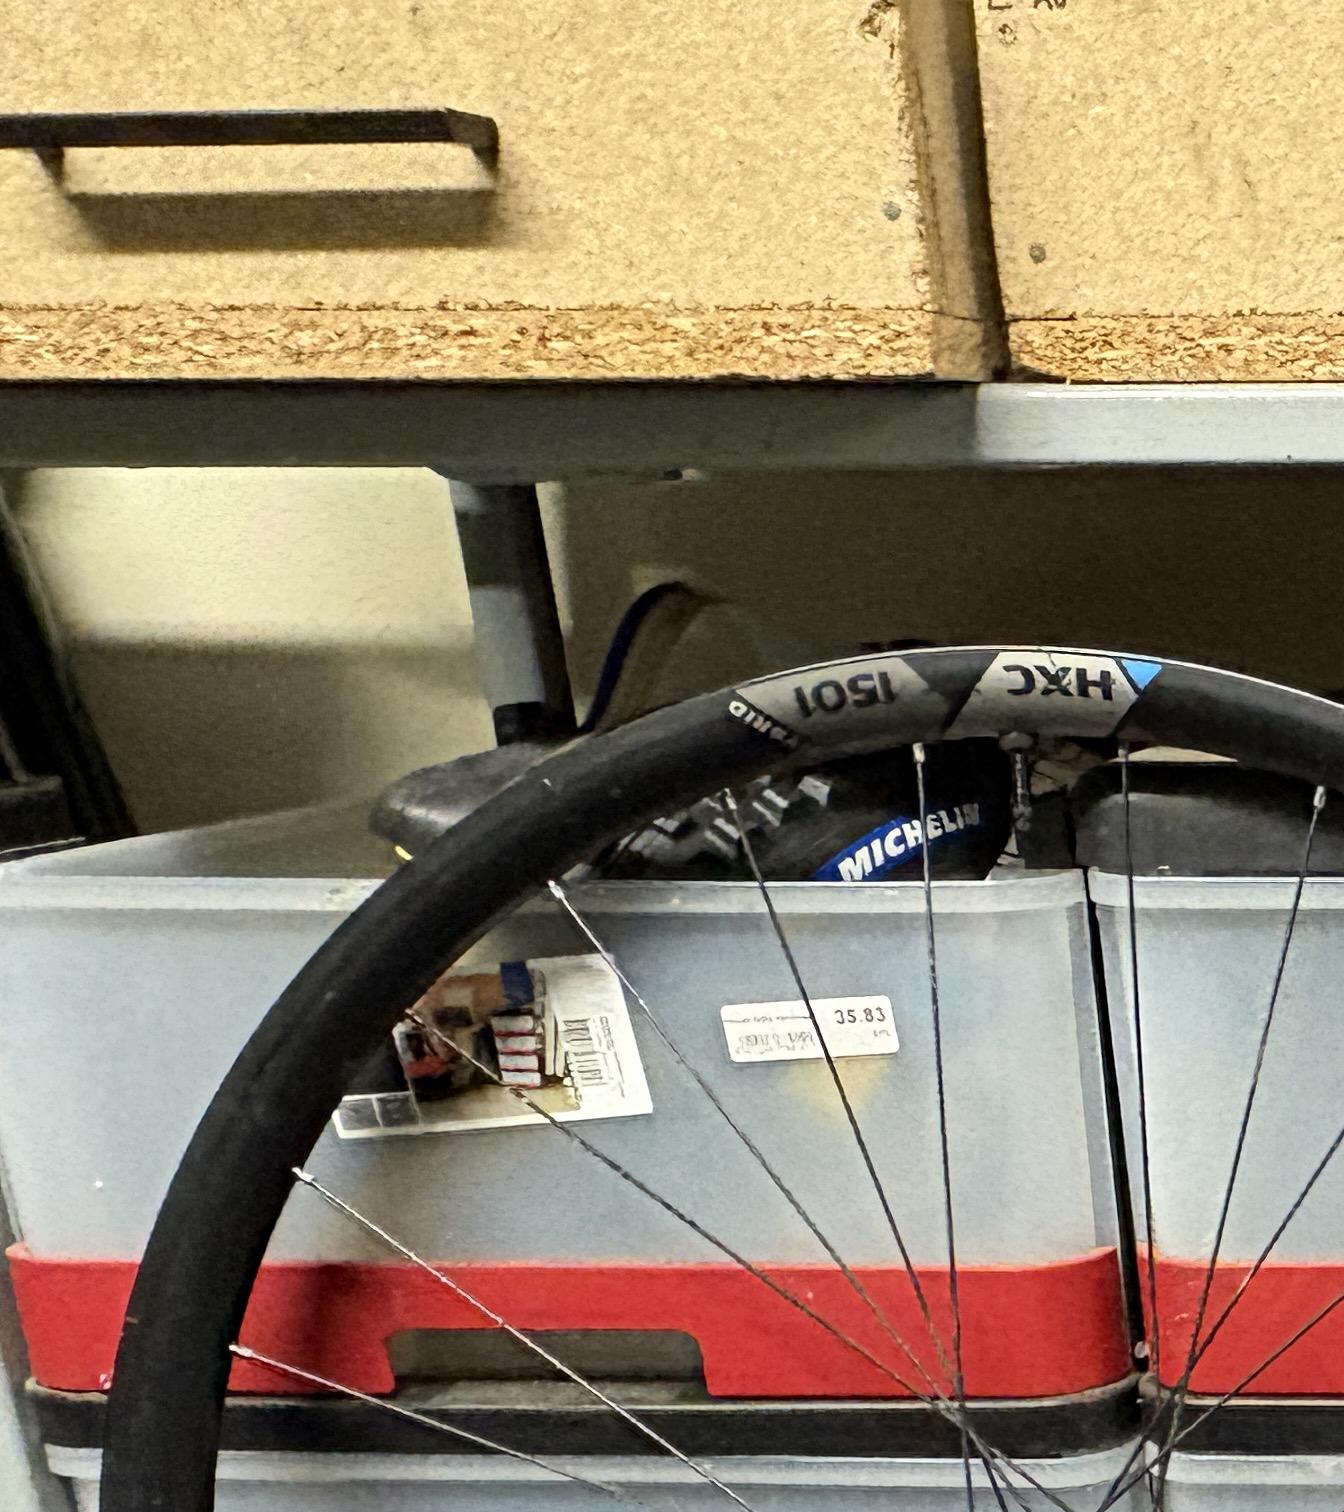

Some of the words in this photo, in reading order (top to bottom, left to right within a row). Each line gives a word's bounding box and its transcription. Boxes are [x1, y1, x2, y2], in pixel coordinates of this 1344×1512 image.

[794, 671, 898, 719] 1501
[1003, 664, 1116, 701] HXC
[834, 1006, 886, 1025] 35.83
